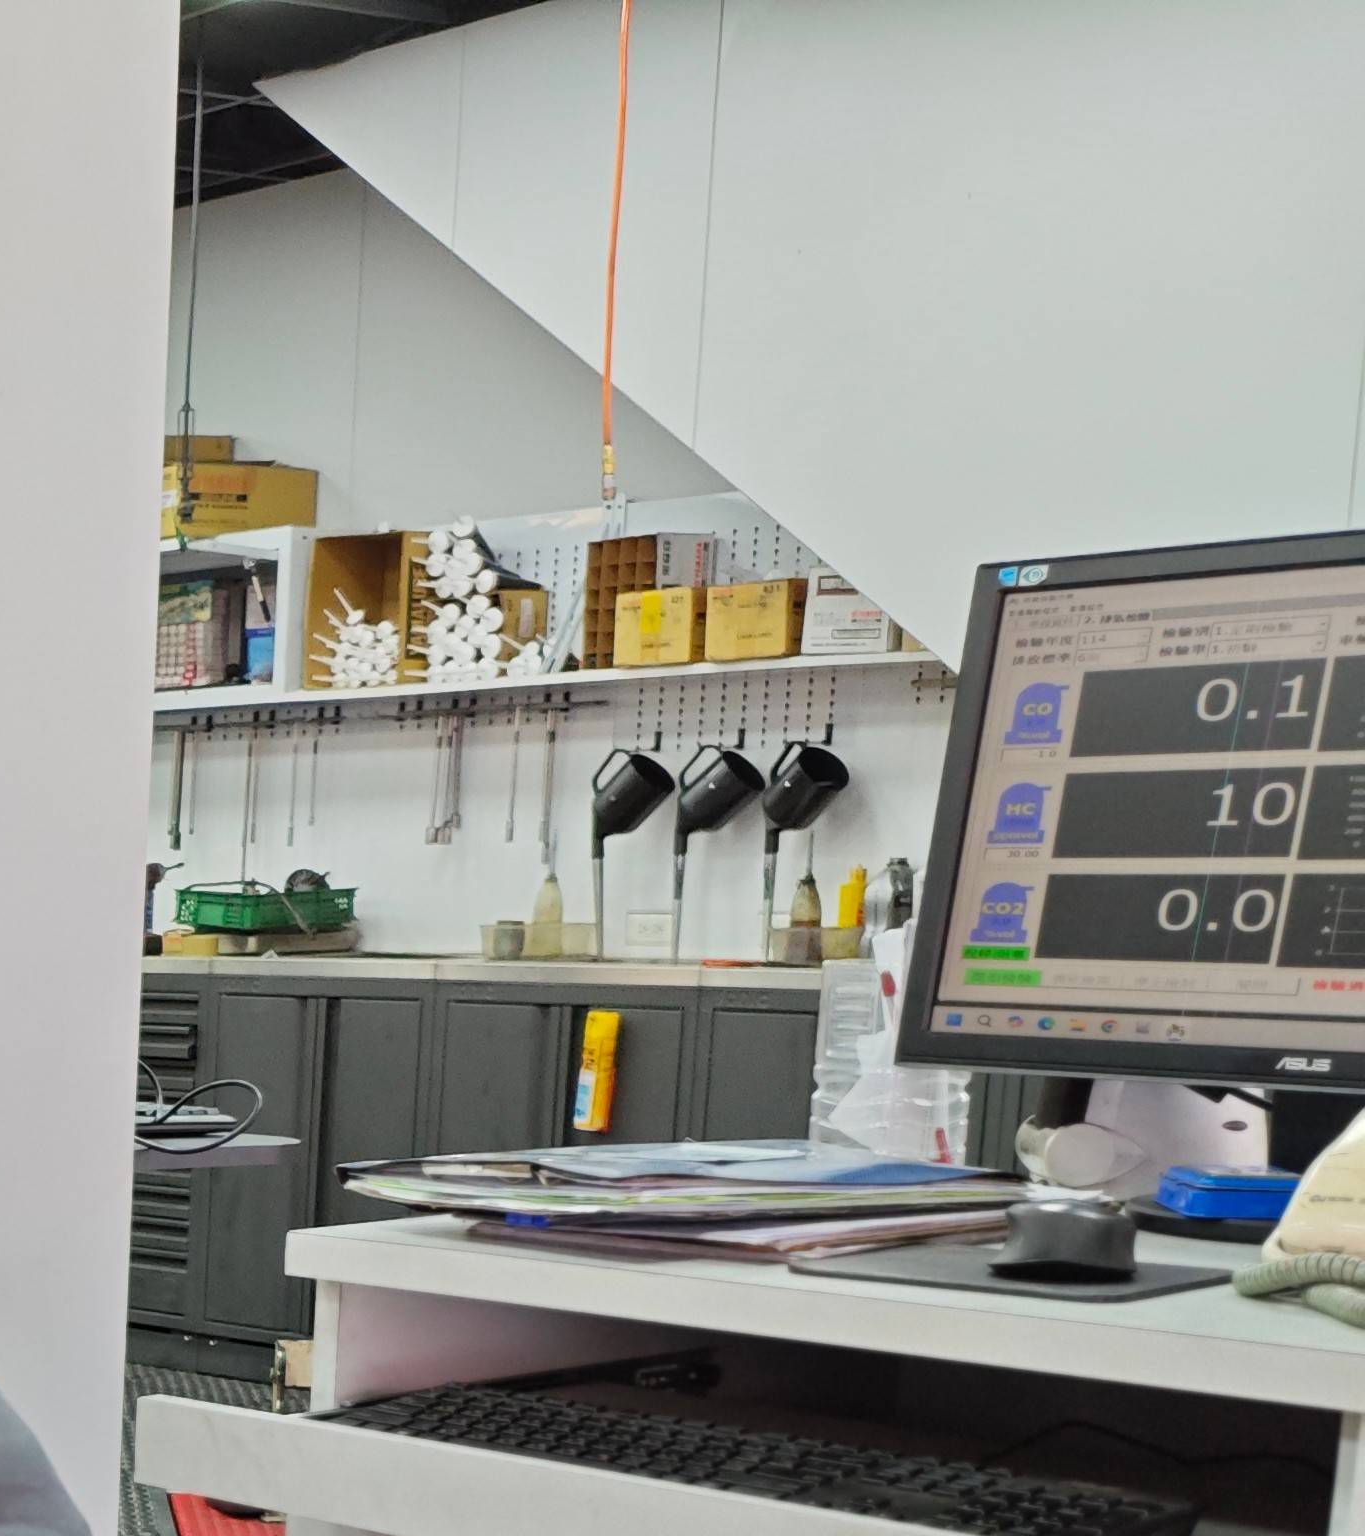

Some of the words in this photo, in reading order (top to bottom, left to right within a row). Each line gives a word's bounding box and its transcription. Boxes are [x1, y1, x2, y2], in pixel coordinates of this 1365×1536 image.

[1195, 673, 1309, 721] 0.1
[1005, 803, 1037, 816] HC
[1206, 781, 1296, 828] 10
[981, 902, 1024, 915] CO2
[1157, 888, 1279, 932] 0.0
[1275, 1056, 1332, 1072] ASUS
